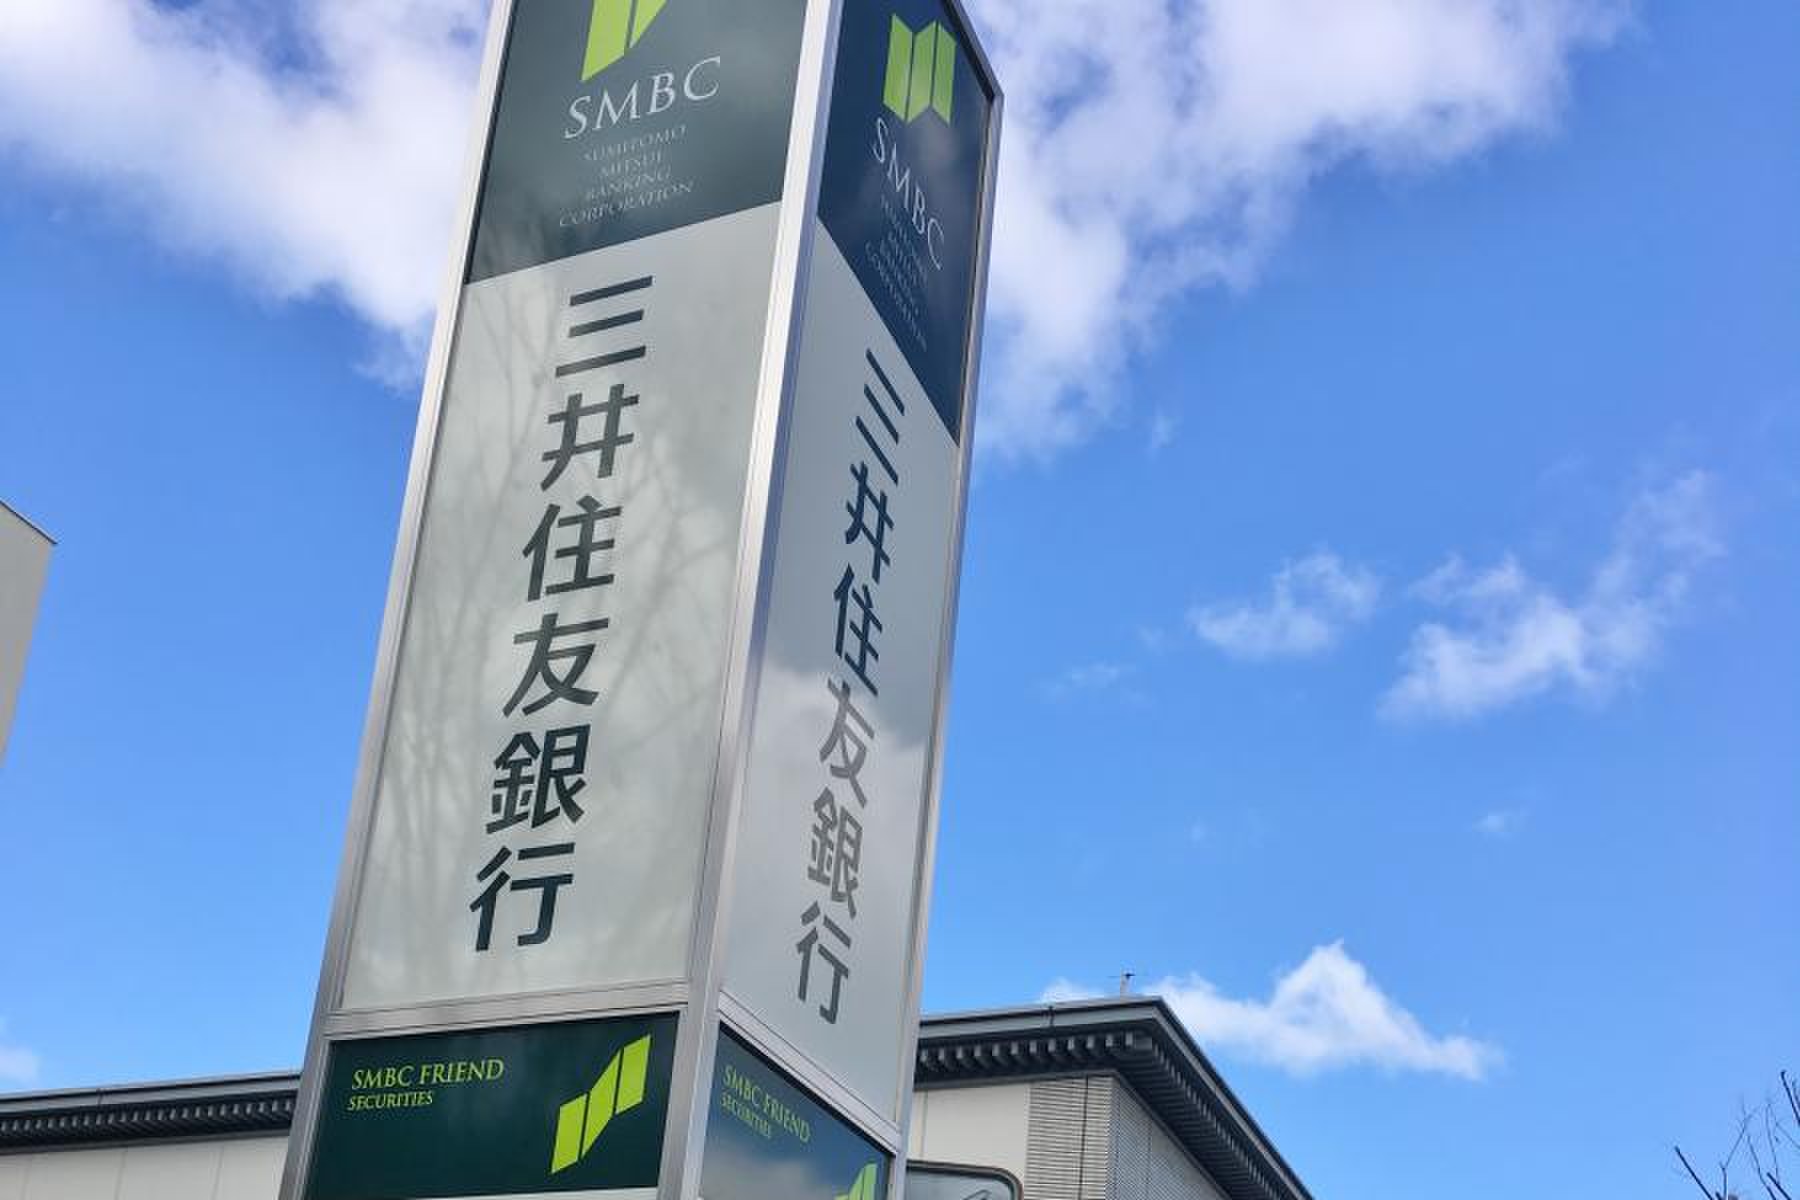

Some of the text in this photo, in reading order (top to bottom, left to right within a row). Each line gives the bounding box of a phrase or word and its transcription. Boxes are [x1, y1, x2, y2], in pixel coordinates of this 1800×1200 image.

[564, 55, 721, 139] SMBC
[872, 116, 945, 271] SMBC
[469, 275, 654, 953] 三井住友銀行
[795, 348, 906, 1025] 三井住友銀行
[346, 1090, 434, 1112] SECURITIES
[351, 1058, 505, 1091] SMBC FRIEND
[723, 1063, 812, 1144] SMBC FRIEND
